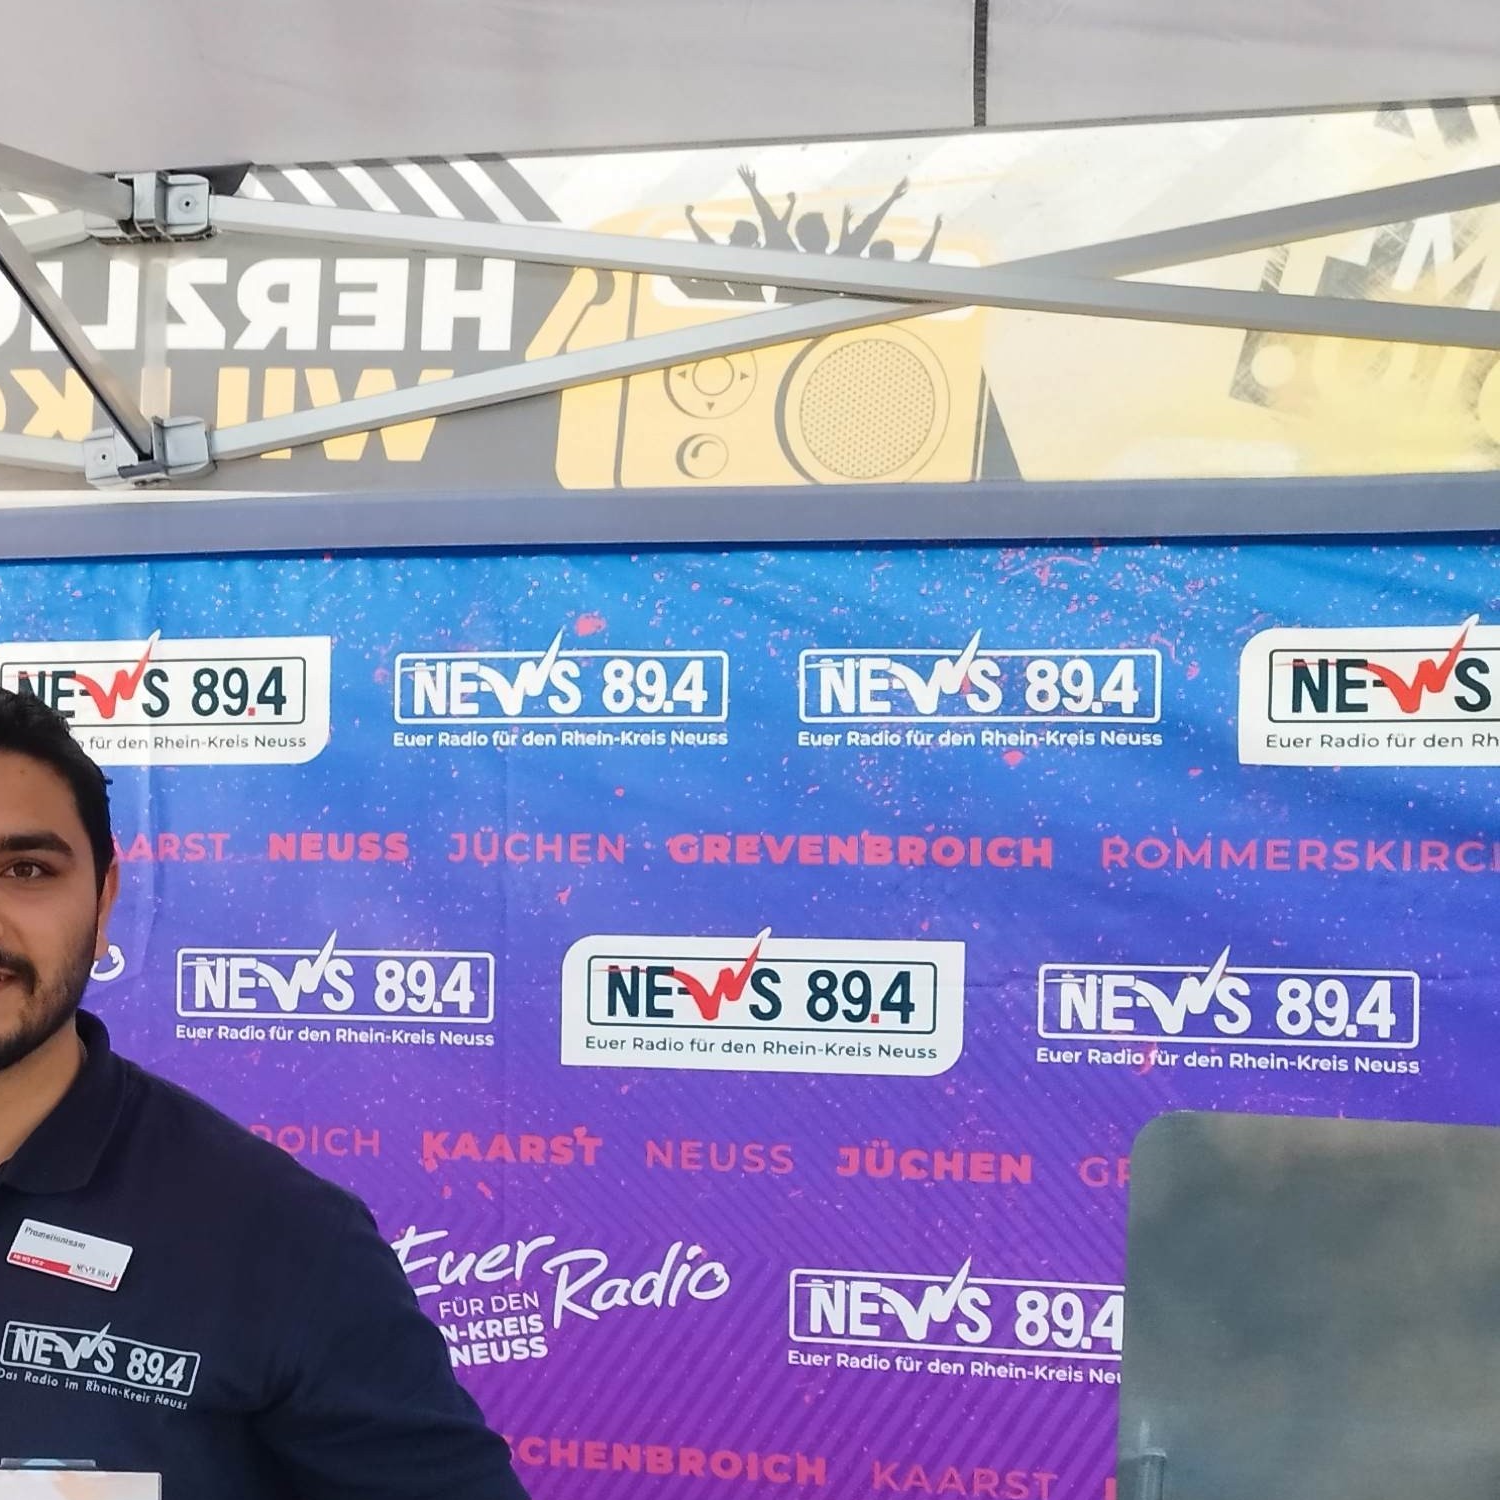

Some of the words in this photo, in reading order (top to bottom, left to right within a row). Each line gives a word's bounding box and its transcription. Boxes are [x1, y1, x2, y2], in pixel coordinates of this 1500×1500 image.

[190, 665, 287, 717] 89.4
[601, 658, 709, 715] 89.4
[1023, 657, 1140, 715] 89.4
[89, 735, 112, 751] für
[116, 736, 148, 750] den
[153, 734, 249, 750] Rhein-Kreis
[254, 734, 307, 750] Neuss
[393, 730, 434, 748] Euer
[437, 729, 489, 748] Radio
[492, 729, 518, 748] für
[521, 730, 558, 747] den
[561, 729, 667, 748] Rhein-Kreis
[670, 730, 729, 747] Neuss
[798, 730, 843, 748] Euer
[846, 729, 901, 748] Radio
[905, 730, 934, 748] für
[937, 730, 976, 747] den
[981, 729, 1097, 748] Rhein-Kreis
[1100, 730, 1164, 747] Neuss
[1265, 733, 1312, 749] Euer
[1320, 733, 1380, 749] Radio
[1386, 733, 1416, 749] für
[1423, 733, 1464, 749] den
[267, 832, 410, 862] NEUSS
[447, 826, 626, 865] JÜCHEN
[667, 832, 1054, 868] GREVENBROICH
[374, 959, 475, 1014] 89.4
[805, 968, 916, 1025] 89.4
[1275, 978, 1397, 1039] 89.4
[175, 1023, 216, 1041] Euer
[218, 1025, 267, 1042] Radio
[269, 1025, 294, 1043] für
[298, 1026, 331, 1043] den
[335, 1027, 436, 1045] Rhein-Kreis
[440, 1030, 495, 1047] Neuss
[585, 1035, 626, 1051] Euer
[632, 1036, 685, 1053] Radio
[689, 1037, 717, 1054] für
[721, 1039, 757, 1055] den
[763, 1039, 872, 1058] Rhein-Kreis
[877, 1043, 938, 1060] Neuss
[1036, 1047, 1083, 1065] Euer
[1087, 1049, 1145, 1067] Radio
[1149, 1050, 1179, 1068] für
[1183, 1051, 1224, 1069] den
[1229, 1052, 1349, 1073] Rhein-Kreis
[1354, 1055, 1421, 1075] Neuss
[422, 1128, 603, 1166] KAARST
[645, 1139, 795, 1176] NEUSS
[836, 1138, 1033, 1184] JÜCHEN
[393, 1225, 556, 1296] Euer
[439, 1295, 485, 1320] FÜR
[490, 1290, 540, 1315] DEN
[542, 1241, 731, 1329] Radio
[440, 1314, 545, 1343] N-KREIS
[1014, 1290, 1124, 1351] 89.4
[126, 1347, 187, 1389] 89.4
[450, 1341, 549, 1369] NEUSS
[788, 1350, 831, 1368] Euer
[836, 1351, 891, 1371] Radio
[895, 1355, 923, 1374] für
[927, 1358, 966, 1376] den
[971, 1361, 1083, 1384] Rhein-Kreis
[24, 1368, 59, 1388] Radio
[65, 1378, 79, 1391] im
[85, 1380, 151, 1404] Rhein-Kreis
[155, 1393, 189, 1411] Neuss
[509, 1435, 828, 1487] CHENBROICH
